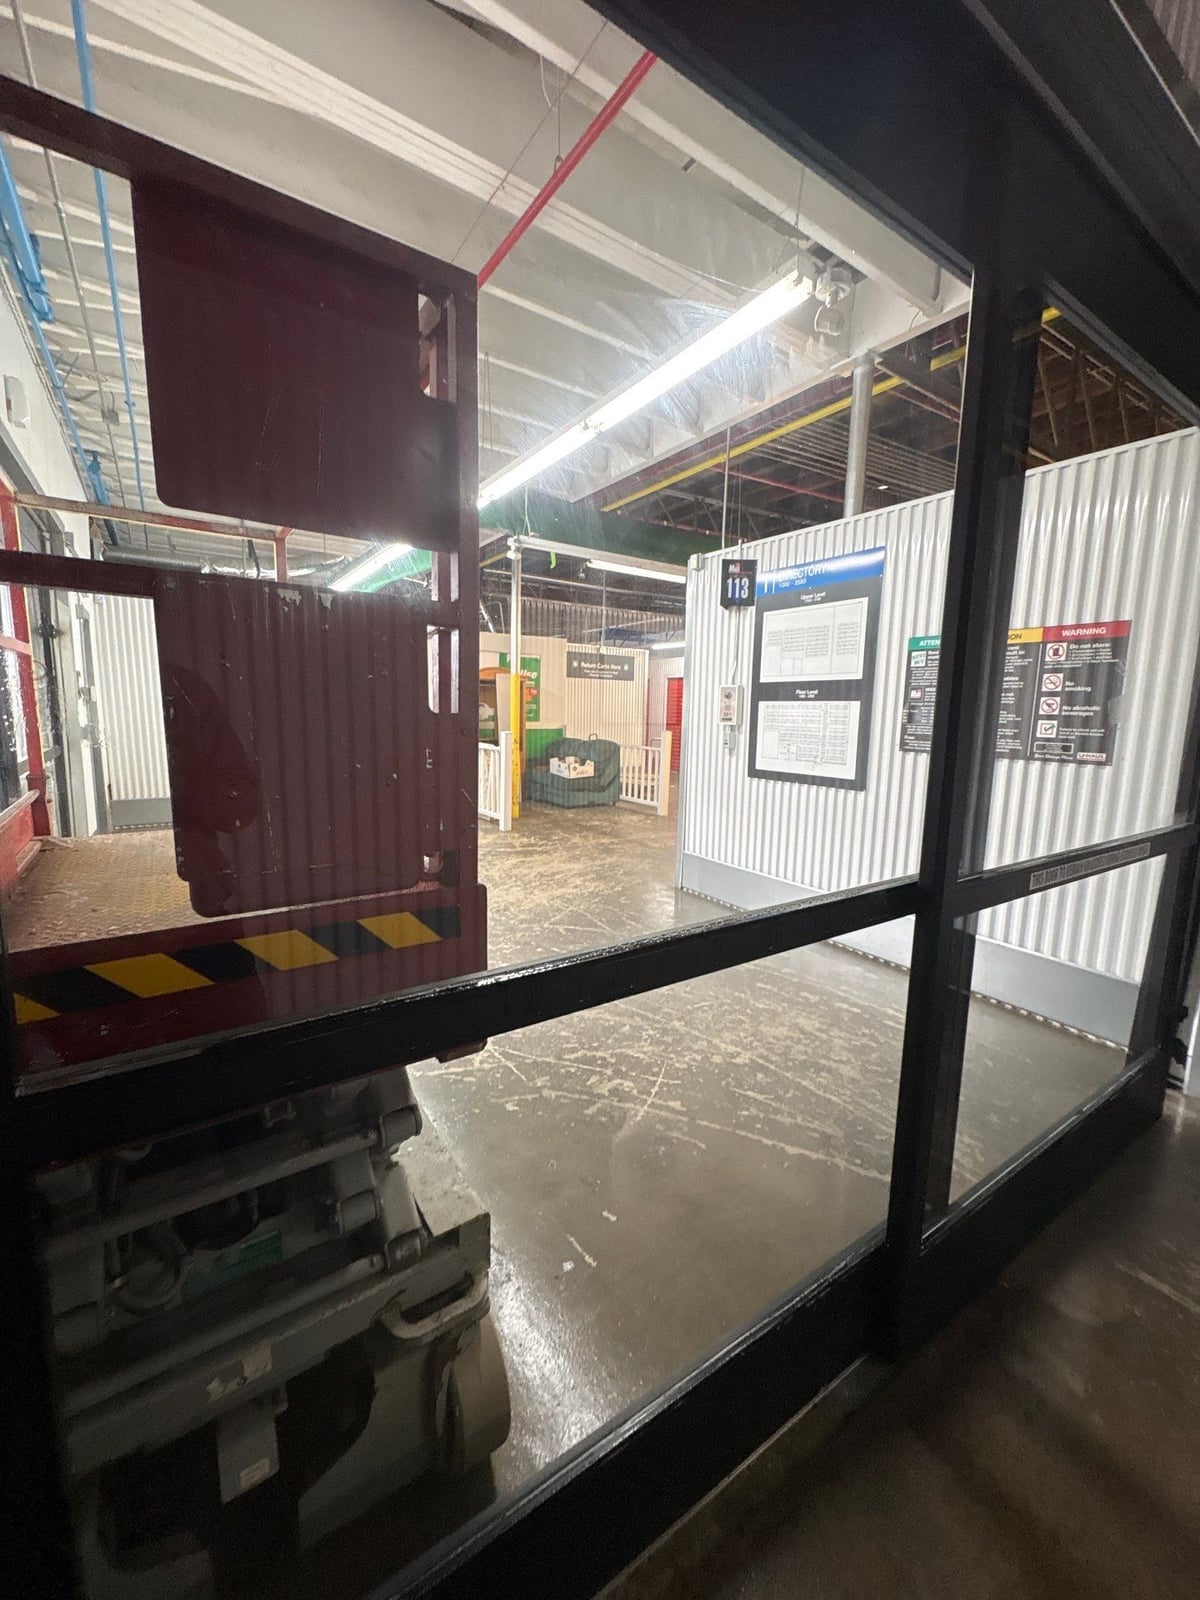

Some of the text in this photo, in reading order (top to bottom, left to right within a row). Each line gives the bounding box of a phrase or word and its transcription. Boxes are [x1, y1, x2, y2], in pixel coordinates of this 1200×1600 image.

[778, 563, 826, 582] DIRECTORY
[727, 577, 749, 599] 113
[1061, 626, 1107, 637] WARNING
